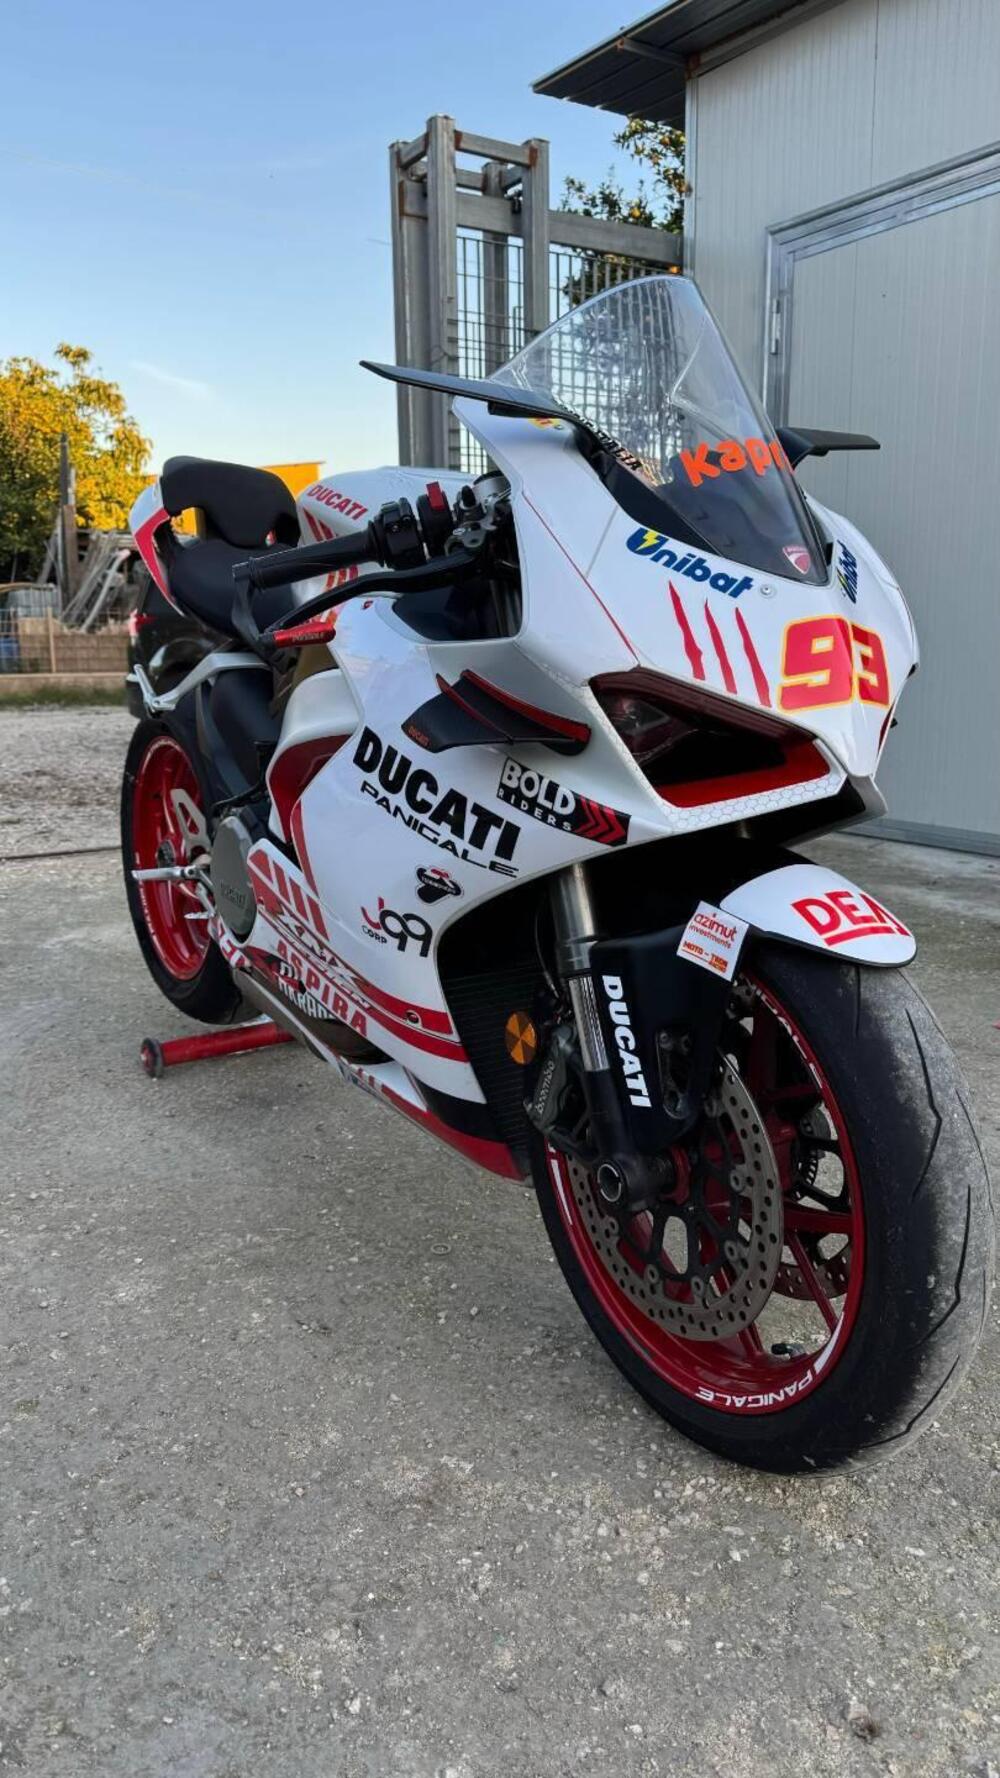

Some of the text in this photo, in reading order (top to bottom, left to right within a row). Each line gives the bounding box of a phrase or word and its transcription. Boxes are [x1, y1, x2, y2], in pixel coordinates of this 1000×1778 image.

[307, 485, 368, 520] DUCATI
[626, 528, 754, 598] Unibat
[778, 615, 890, 712] 93
[353, 726, 521, 861] DUCATI
[499, 788, 573, 831] RIDERS
[501, 761, 577, 816] BOLD
[360, 781, 519, 878] PANIGALE
[361, 925, 388, 944] CORP
[694, 913, 738, 941] azimut
[277, 940, 368, 1037] ASPIRA
[602, 975, 652, 1108] DUCATI
[694, 1369, 814, 1408] PANIGALE
